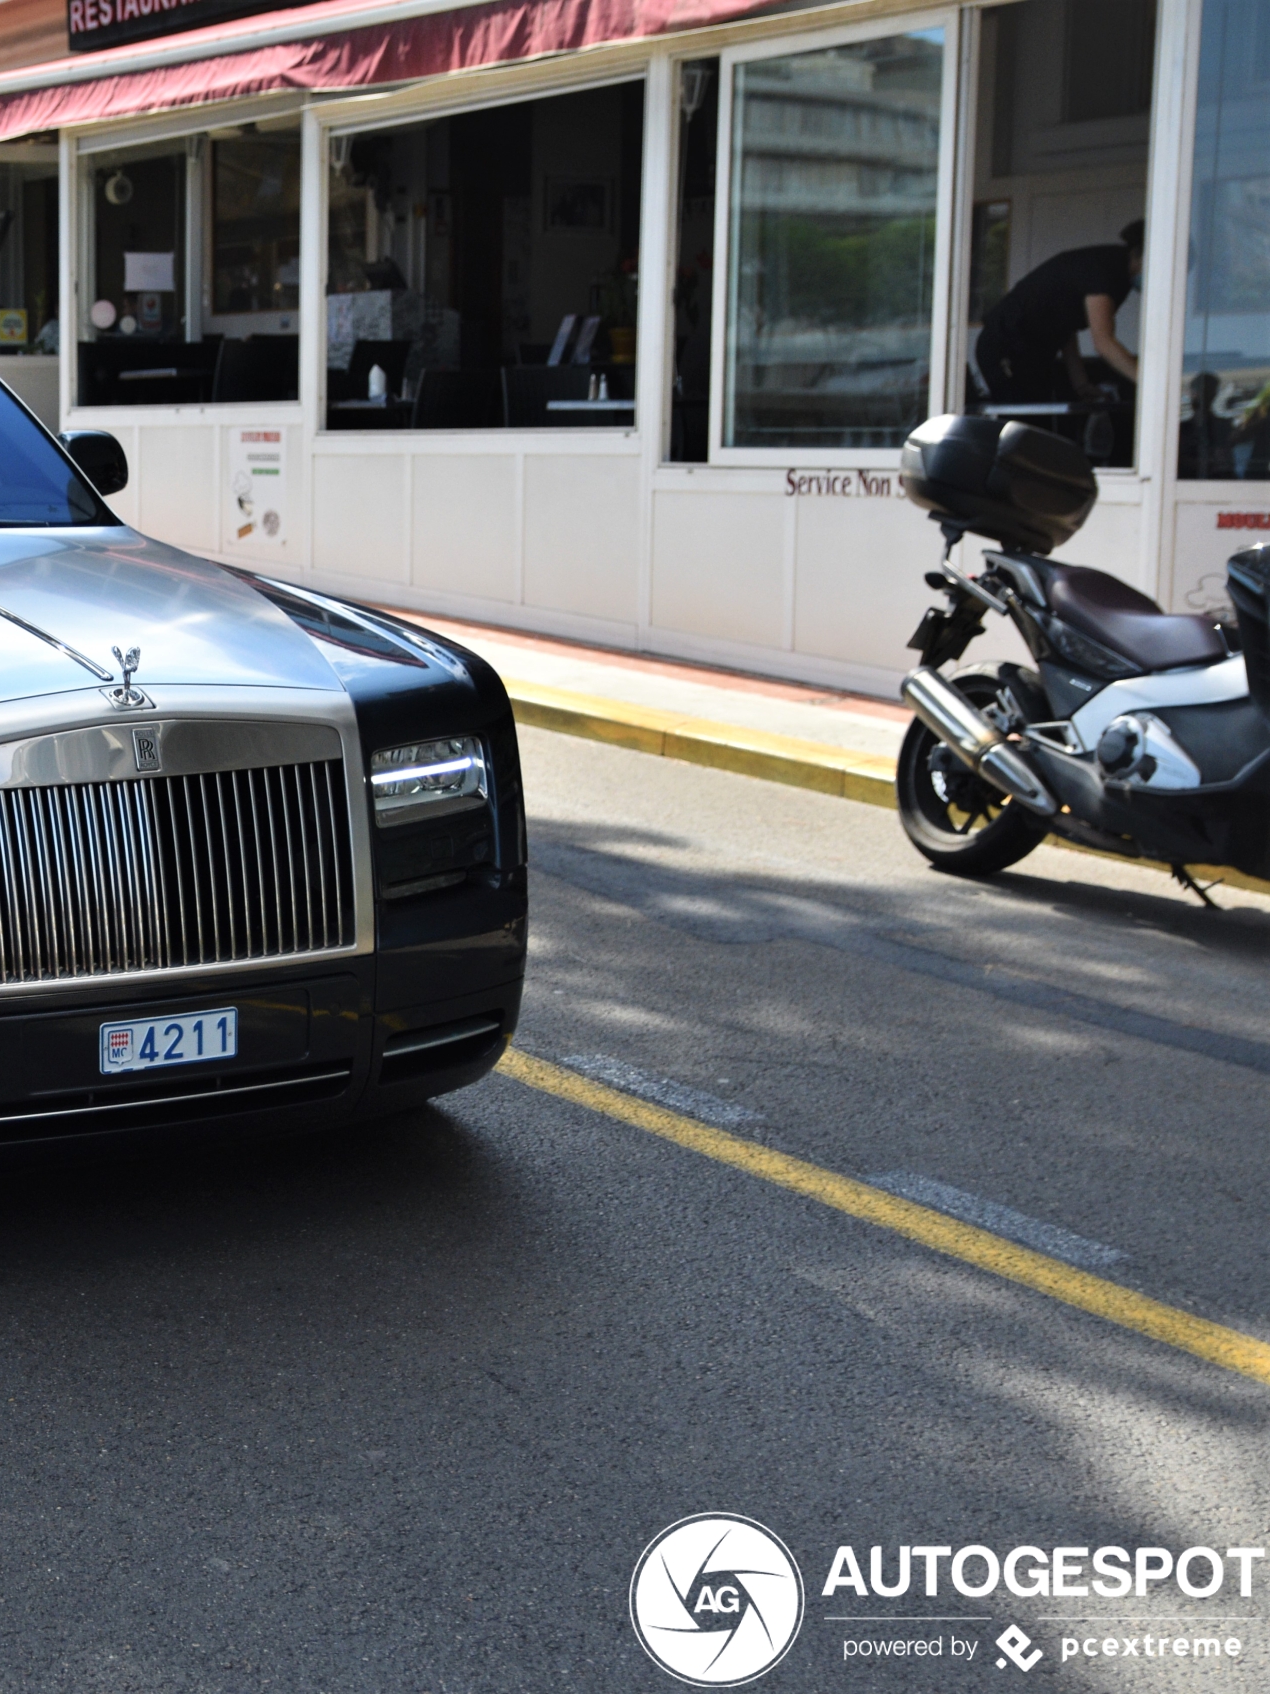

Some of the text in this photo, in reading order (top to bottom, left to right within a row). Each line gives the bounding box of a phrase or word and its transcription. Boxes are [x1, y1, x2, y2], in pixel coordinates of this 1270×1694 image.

[785, 468, 851, 496] Service
[856, 469, 891, 497] Non
[139, 1016, 228, 1062] 4211
